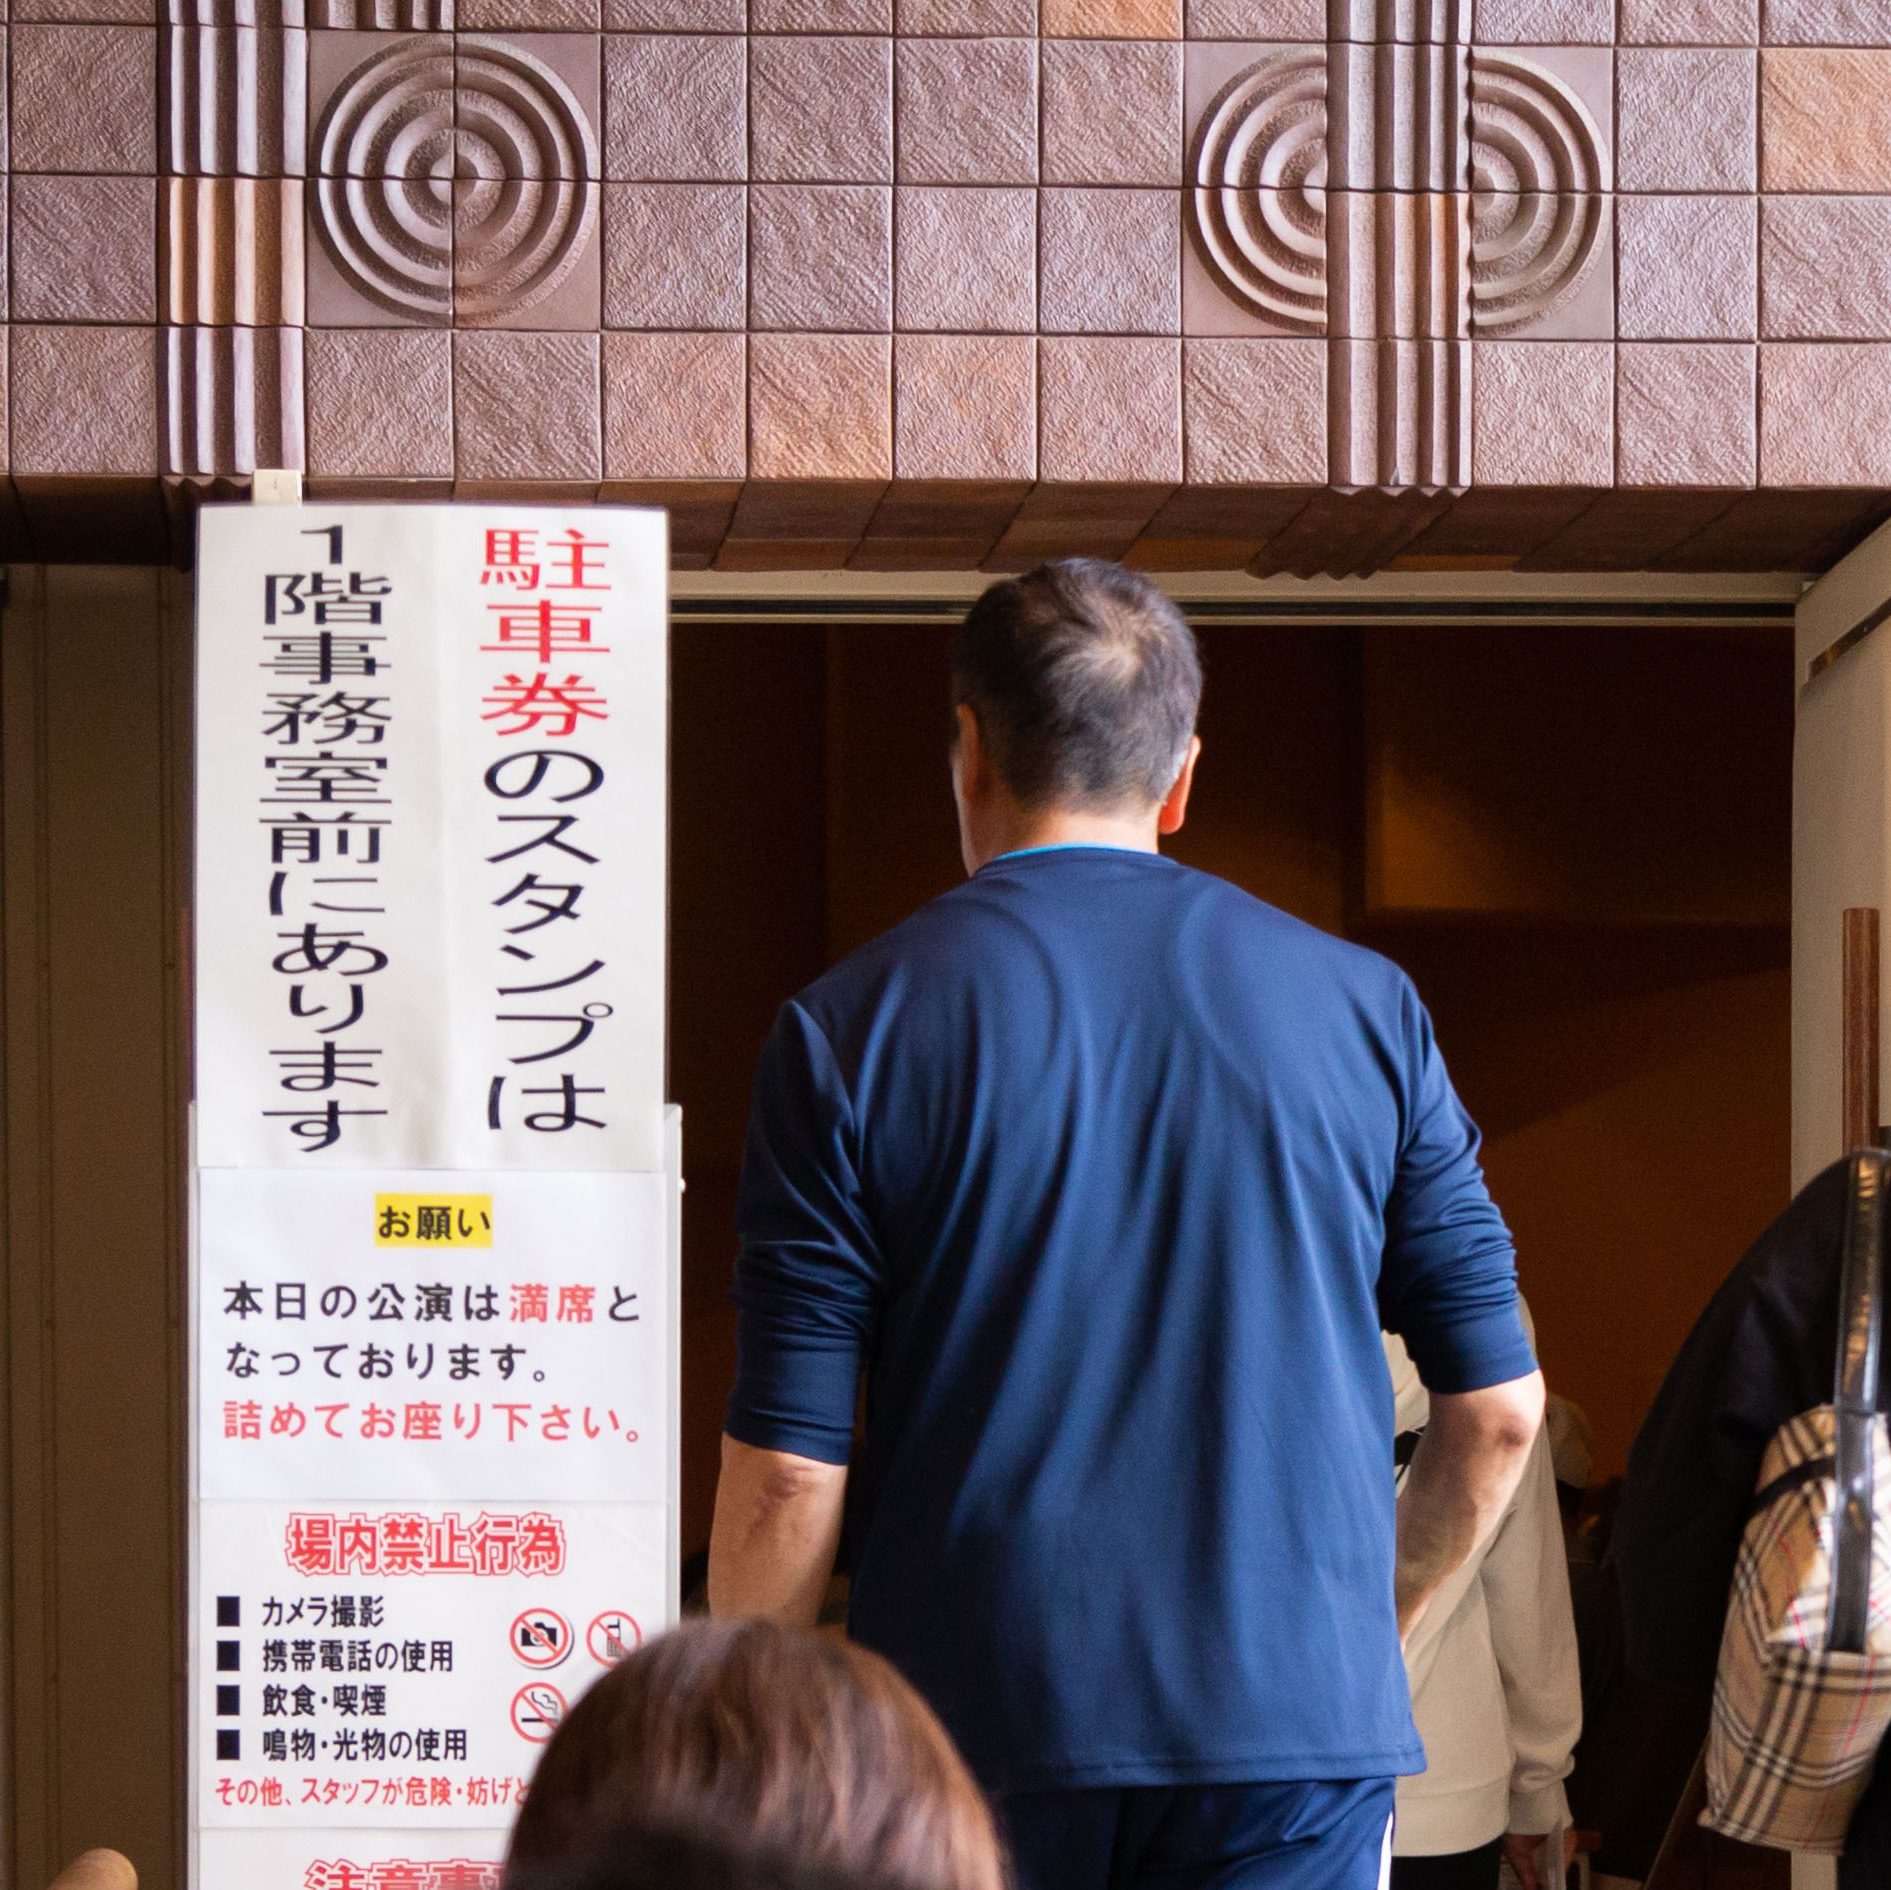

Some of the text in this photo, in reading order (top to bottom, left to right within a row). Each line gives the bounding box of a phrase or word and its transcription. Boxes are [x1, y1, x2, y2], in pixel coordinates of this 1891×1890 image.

[260, 524, 394, 1153] 1階事務室前にあります
[480, 528, 614, 1132] 駐車券のスタンプは
[378, 1206, 490, 1241] お願い
[223, 1281, 641, 1323] 本日の公演は満席と
[226, 1343, 546, 1383] なっております。
[224, 1400, 640, 1444] 詰めてお座り下さい。
[286, 1512, 567, 1576] 場内禁止行為
[262, 1596, 385, 1628] カメラ撮影
[262, 1640, 453, 1672] 携帯電話の使用
[263, 1684, 387, 1717] 飲食・喫煙
[263, 1728, 467, 1762] 鳴物・光物の使用
